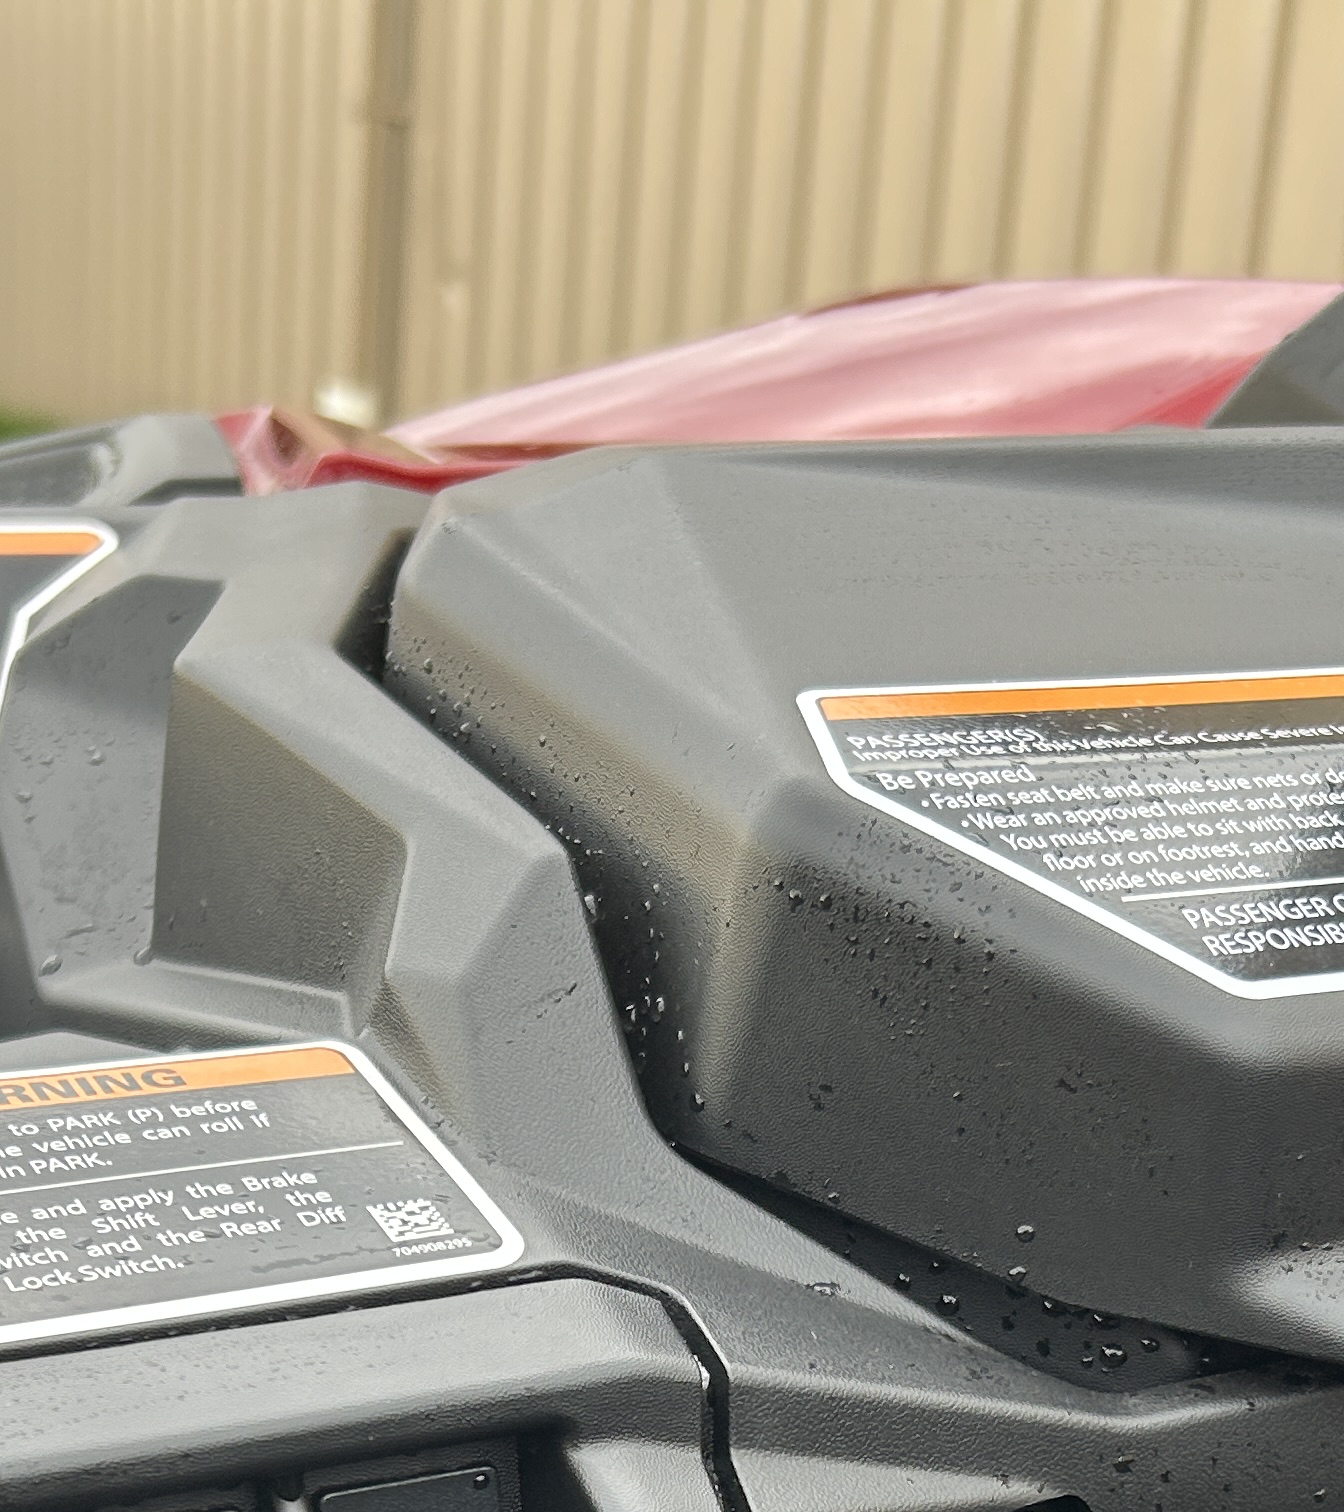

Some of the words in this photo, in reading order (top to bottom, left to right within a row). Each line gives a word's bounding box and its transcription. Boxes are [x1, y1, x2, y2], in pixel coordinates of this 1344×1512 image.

[846, 728, 1045, 752] PASSENGER(S)
[876, 772, 917, 791] Be
[917, 763, 1037, 795] Prepared
[929, 790, 1007, 810] Fasten
[1006, 785, 1056, 806] seat
[1052, 783, 1102, 802] belt
[1101, 779, 1145, 799] and
[1144, 777, 1206, 797] make
[1205, 777, 1255, 792] sure
[1254, 773, 1299, 789] nets
[1299, 770, 1324, 786] or
[1181, 896, 1336, 930] PASSENGER
[7, 1122, 40, 1137] to
[46, 1111, 122, 1133] PARK
[127, 1106, 164, 1125] (P)
[169, 1099, 258, 1118] before
[31, 1130, 132, 1153] vehicle
[142, 1125, 192, 1141] can
[199, 1115, 245, 1135] roll
[249, 1112, 271, 1129] if
[28, 1151, 113, 1175] PARK.
[30, 1198, 88, 1220] and
[97, 1188, 174, 1217] apply
[185, 1182, 244, 1199] the
[240, 1171, 318, 1192] Brake
[13, 1226, 68, 1246] the
[91, 1211, 161, 1234] Shift
[180, 1200, 265, 1221] Lever,
[284, 1190, 333, 1207] the
[85, 1234, 143, 1258] and
[155, 1226, 222, 1247] the
[218, 1215, 282, 1239] Rear
[295, 1205, 347, 1227] Diff
[0, 1268, 79, 1292] Lock
[77, 1254, 185, 1282] Switch.
